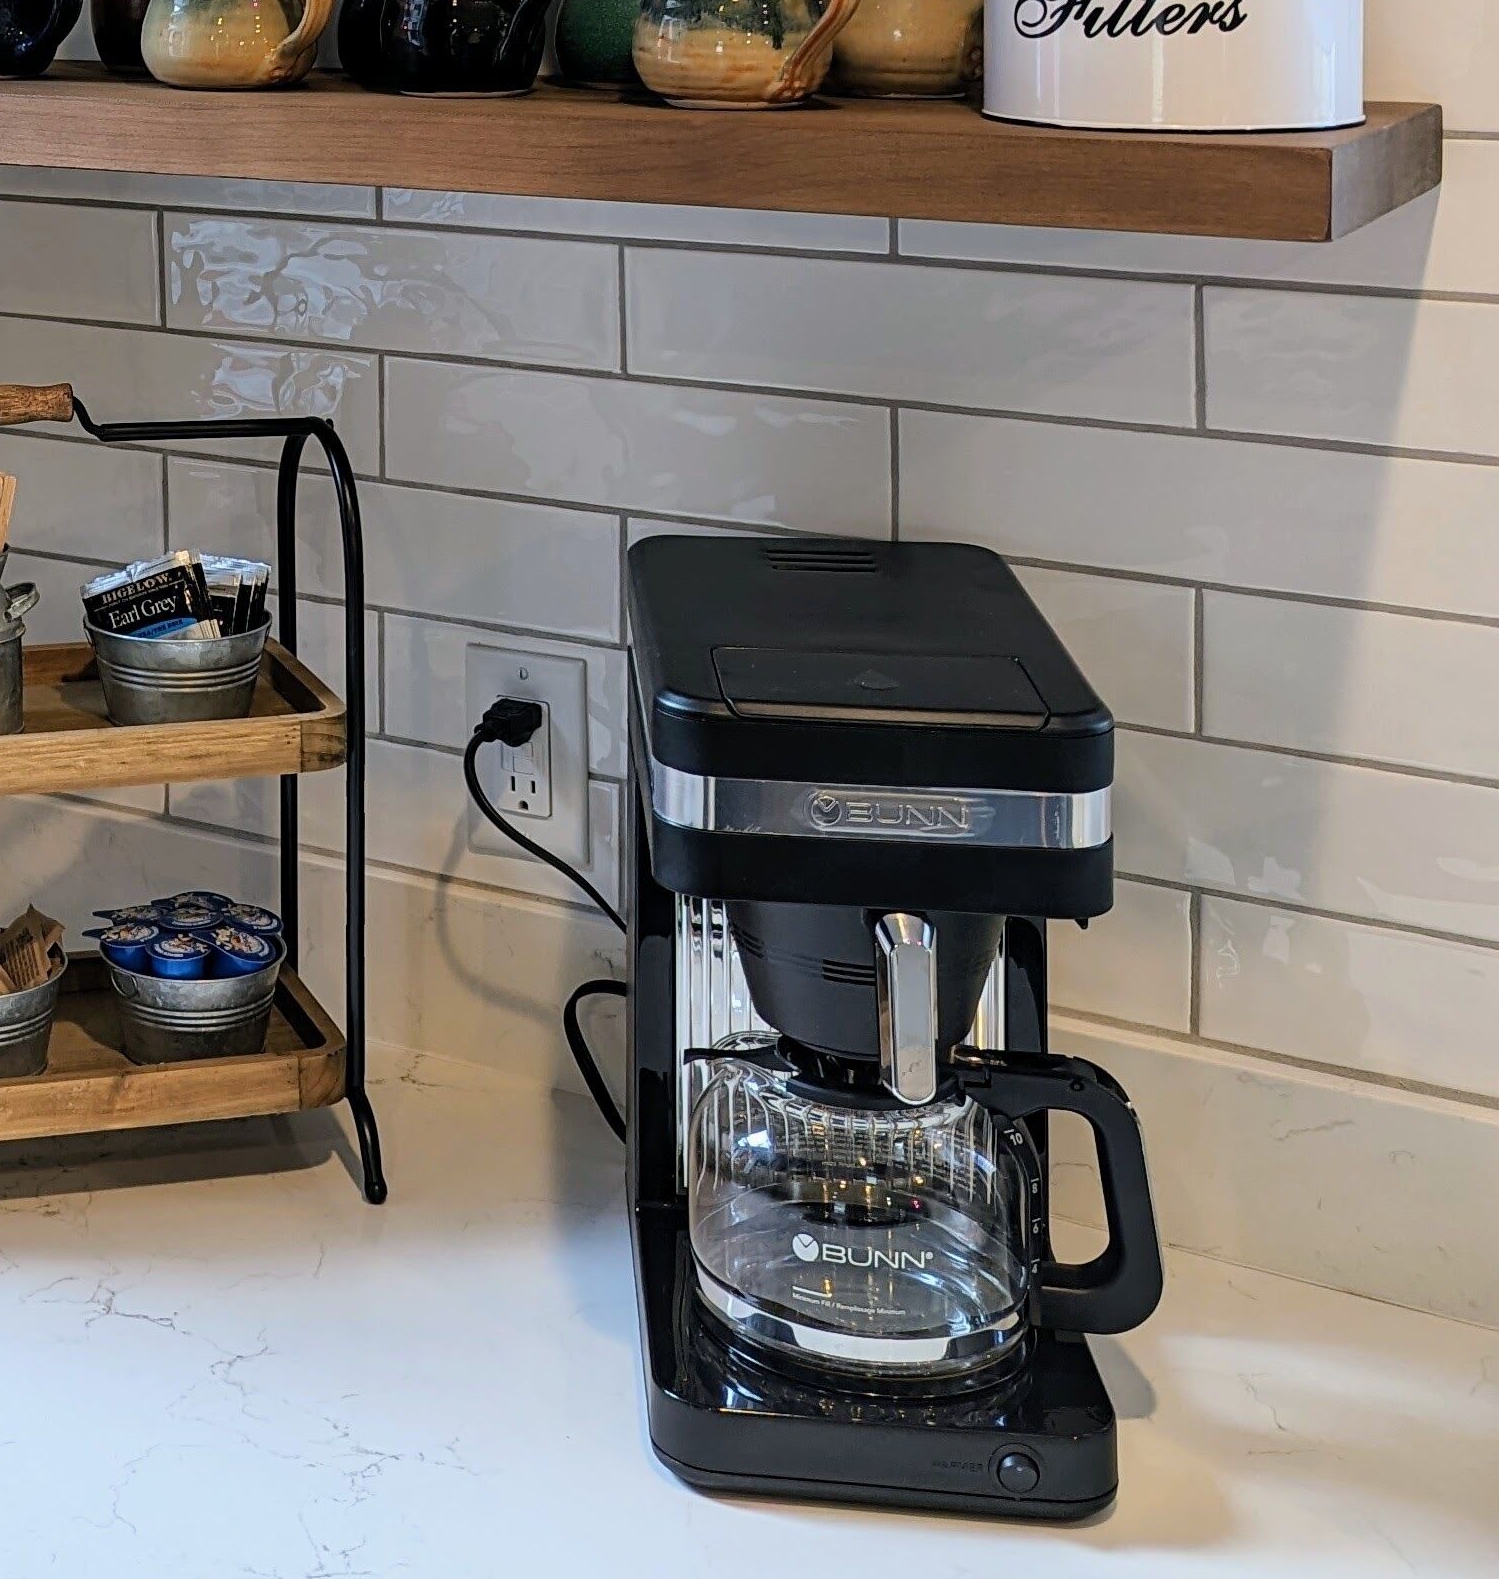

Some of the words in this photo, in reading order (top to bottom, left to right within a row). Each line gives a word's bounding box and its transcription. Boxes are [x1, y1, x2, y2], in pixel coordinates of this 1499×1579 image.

[108, 604, 140, 629] Earl
[141, 596, 176, 617] Grey
[845, 801, 969, 829] BUNN
[1010, 1132, 1024, 1146] 10
[1031, 1182, 1038, 1194] 8
[1032, 1223, 1039, 1234] 6
[822, 1243, 925, 1269] BUNN
[1031, 1263, 1038, 1274] 4
